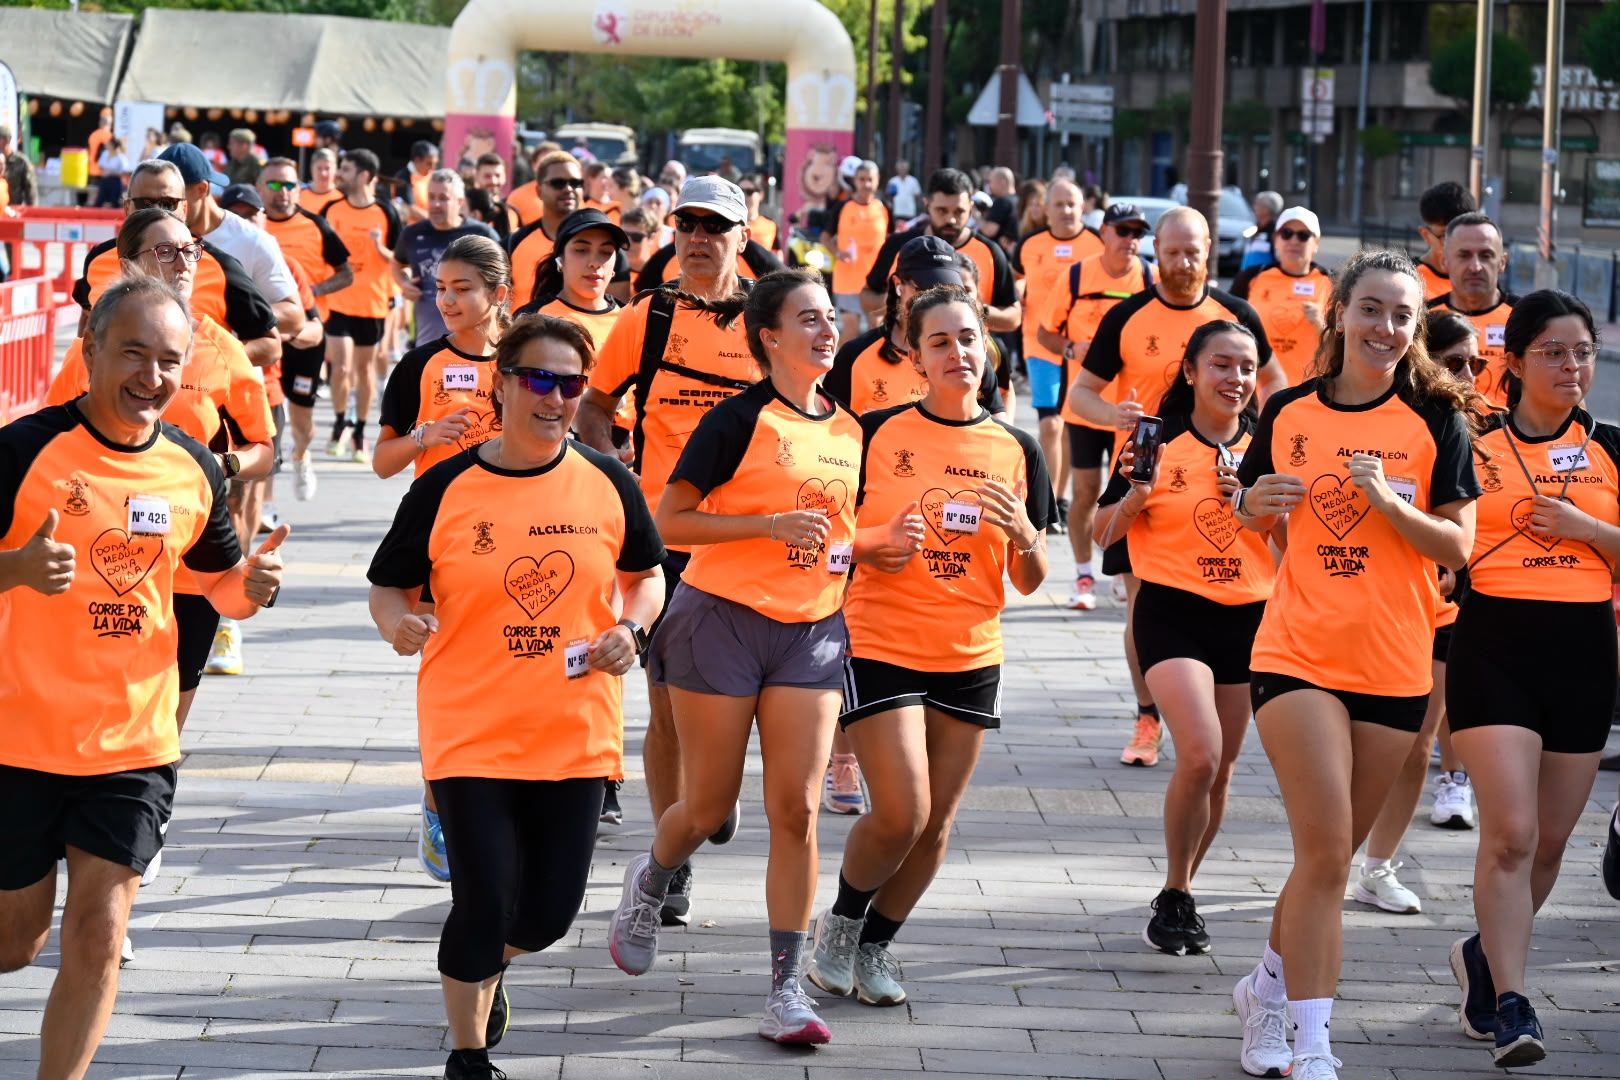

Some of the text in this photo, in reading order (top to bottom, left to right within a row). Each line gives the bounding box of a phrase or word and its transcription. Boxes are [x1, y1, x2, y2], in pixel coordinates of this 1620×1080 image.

[459, 374, 475, 382] 194
[659, 398, 714, 407] POR LA
[148, 512, 167, 524] 426
[960, 513, 977, 525] 058
[1326, 504, 1353, 521] DONA
[95, 542, 127, 556] DONA
[922, 548, 970, 563] CORRE POR
[1317, 544, 1369, 559] CORRE POR
[787, 549, 800, 563] LA
[1197, 557, 1226, 567] CORRE
[1523, 556, 1558, 568] CORRE
[106, 558, 137, 576] DONA
[928, 561, 940, 573] LA
[1324, 557, 1338, 570] LA
[509, 568, 539, 587] DONA
[1203, 566, 1215, 578] LA
[521, 582, 551, 601] DONA
[88, 602, 148, 618] CORRE POR
[93, 616, 109, 630] LA
[503, 625, 561, 638] CORRE POR
[508, 638, 523, 651] LA
